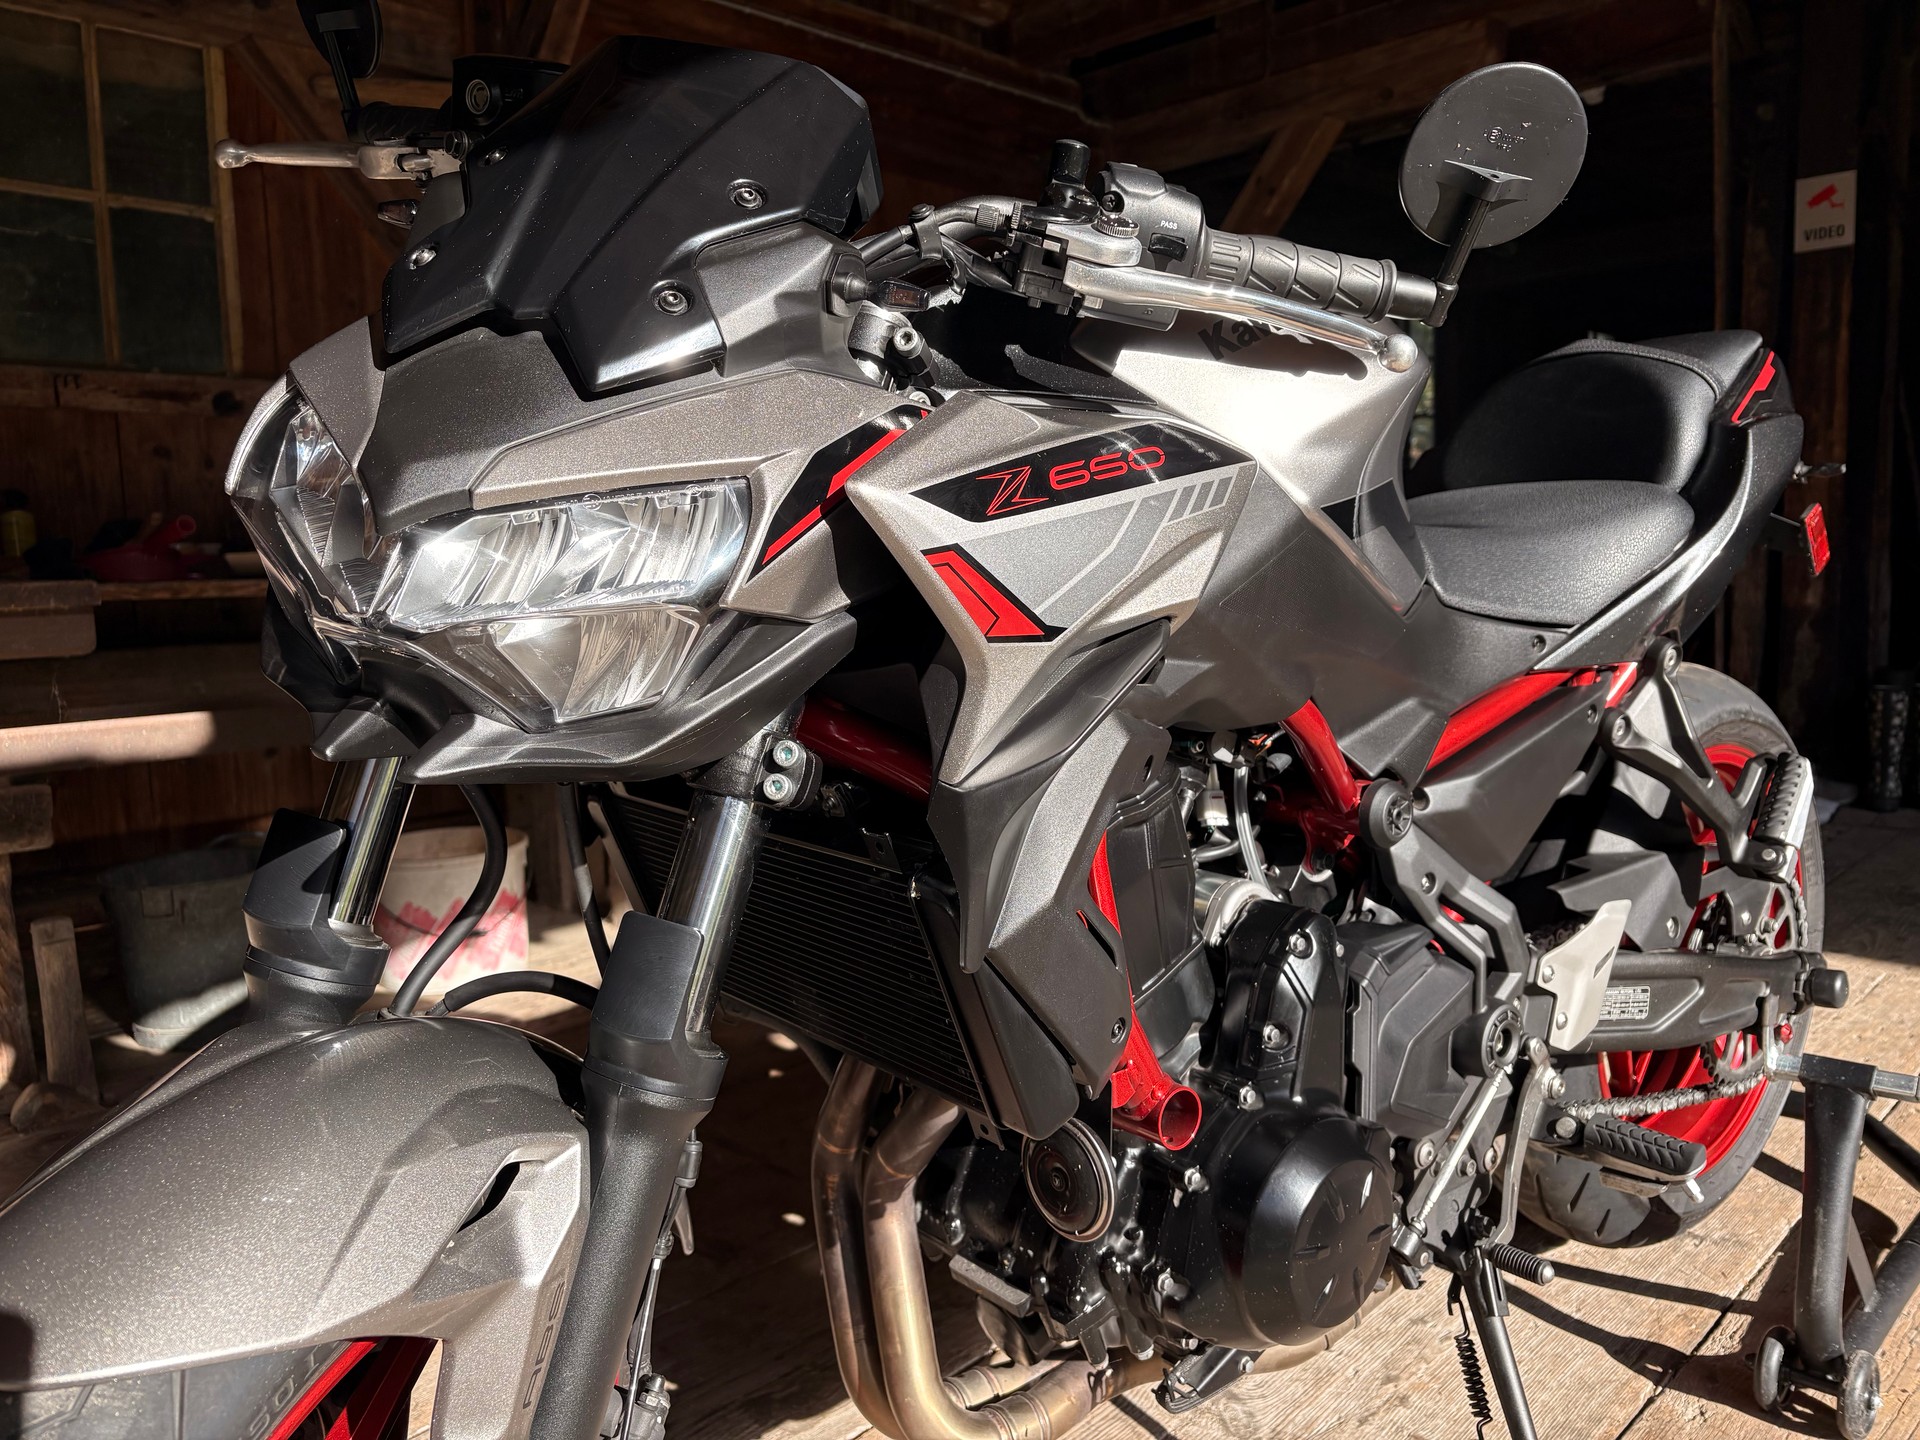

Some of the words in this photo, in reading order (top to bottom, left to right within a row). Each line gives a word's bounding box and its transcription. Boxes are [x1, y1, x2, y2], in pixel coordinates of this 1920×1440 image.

[1160, 220, 1178, 230] PASS
[1804, 224, 1846, 242] VIDEO
[1049, 446, 1166, 491] 650
[522, 1280, 566, 1410] ABS
